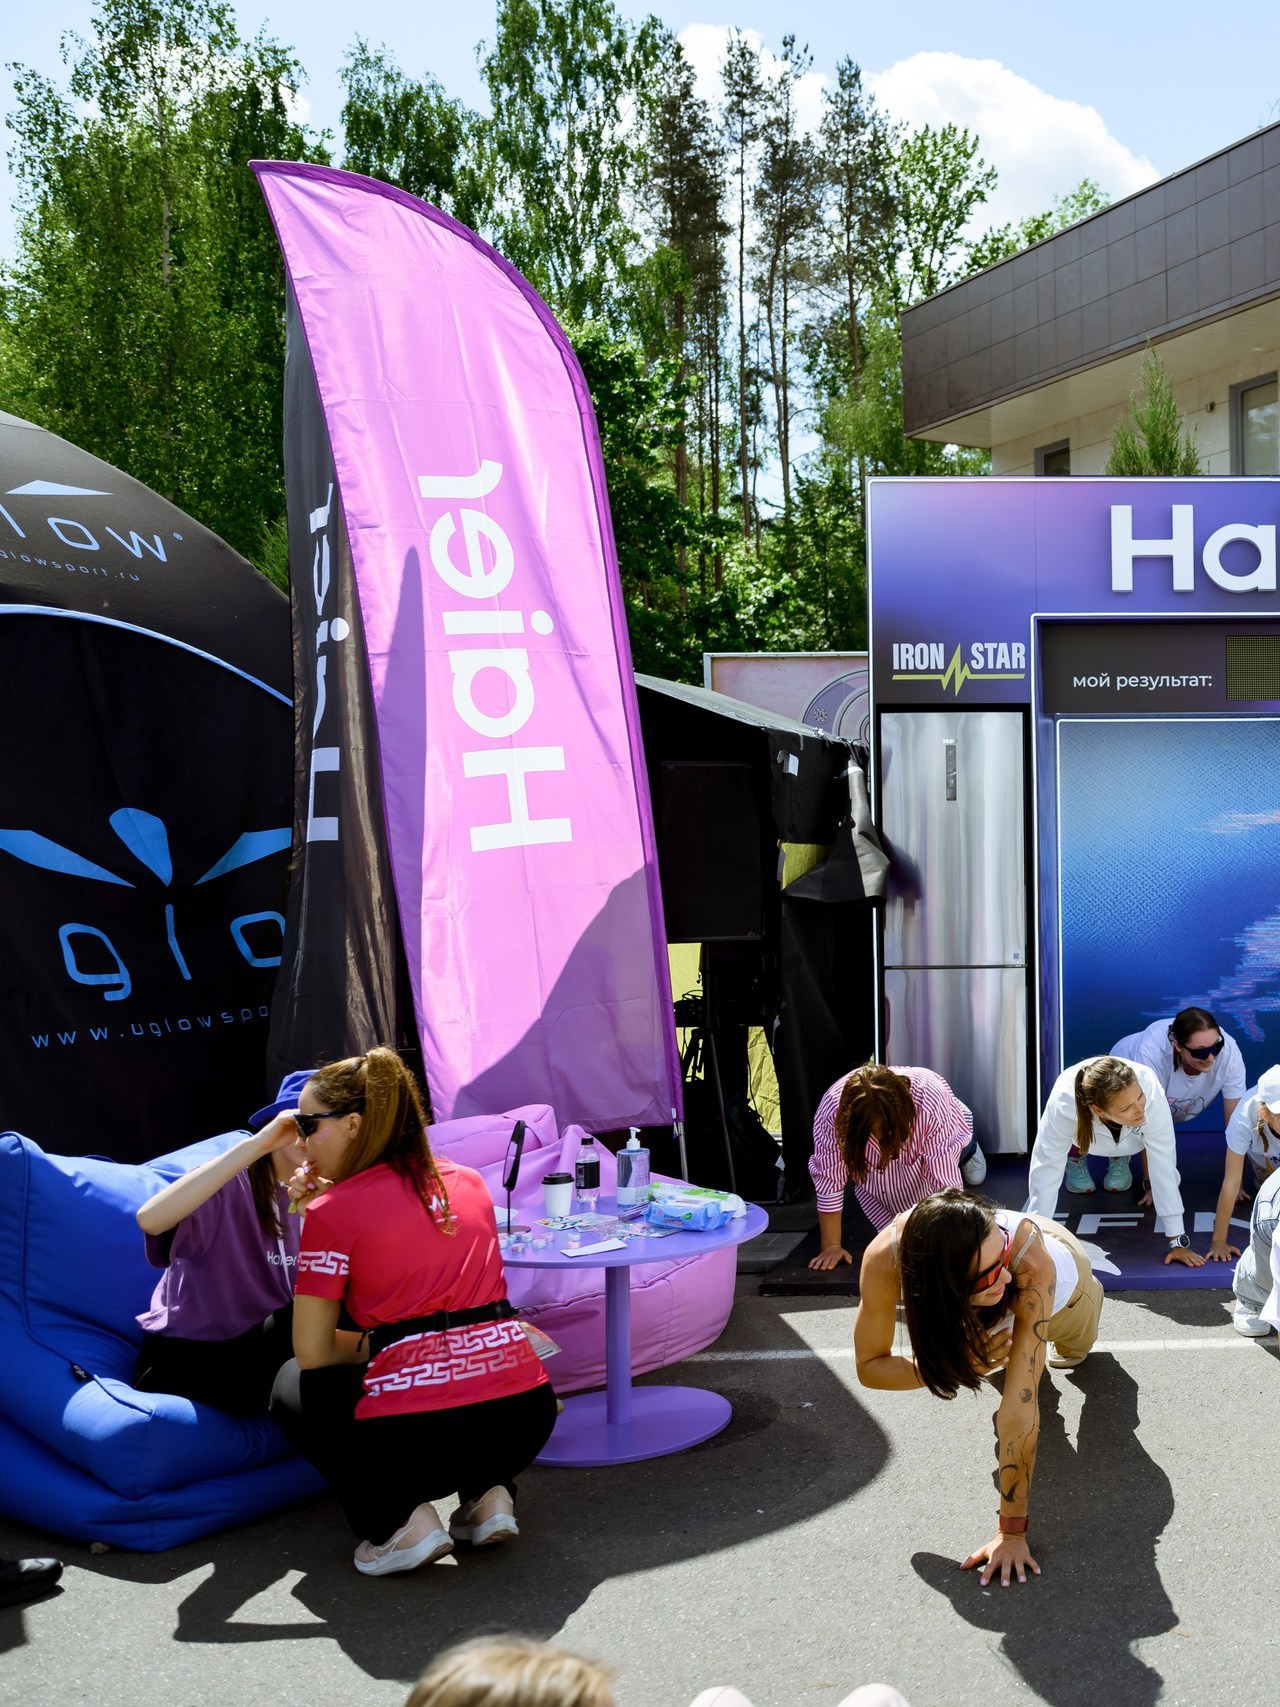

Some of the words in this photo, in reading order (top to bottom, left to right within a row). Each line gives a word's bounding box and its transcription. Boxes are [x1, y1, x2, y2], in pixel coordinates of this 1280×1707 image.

[417, 458, 573, 853] Haier
[892, 643, 945, 670] IRON
[970, 643, 1026, 670] STAR
[1072, 672, 1111, 688] мой
[1116, 673, 1213, 691] результат:
